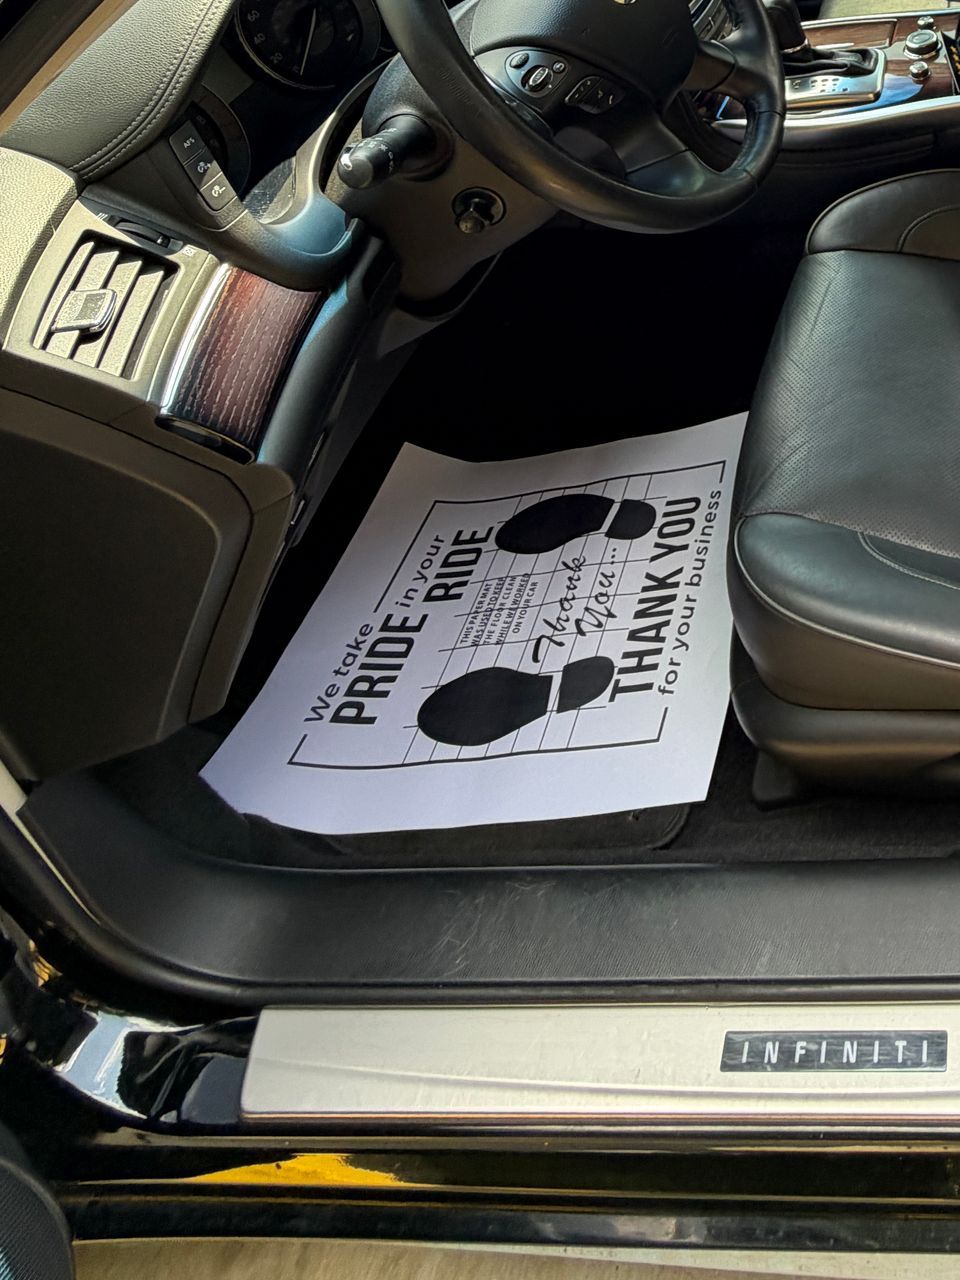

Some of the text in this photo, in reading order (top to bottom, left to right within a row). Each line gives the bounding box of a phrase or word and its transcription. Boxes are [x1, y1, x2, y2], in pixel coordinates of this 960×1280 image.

[422, 526, 495, 603] RIDE
[608, 497, 701, 702] THANK YOU
[658, 490, 721, 695] for your business
[329, 534, 445, 725] PRIDE in your
[460, 583, 493, 644] THIS PAPER MAT
[470, 629, 484, 646] WAS
[478, 607, 493, 628] USED
[487, 596, 497, 607] TO
[483, 576, 517, 645] THE FLOOR CLEAN
[495, 620, 511, 645] WHILE
[511, 573, 531, 607] WORKED
[512, 581, 539, 634] ON YOUR CAR
[532, 555, 587, 664] Thank
[303, 622, 374, 723] We take
[741, 1040, 928, 1064] INFINITI
